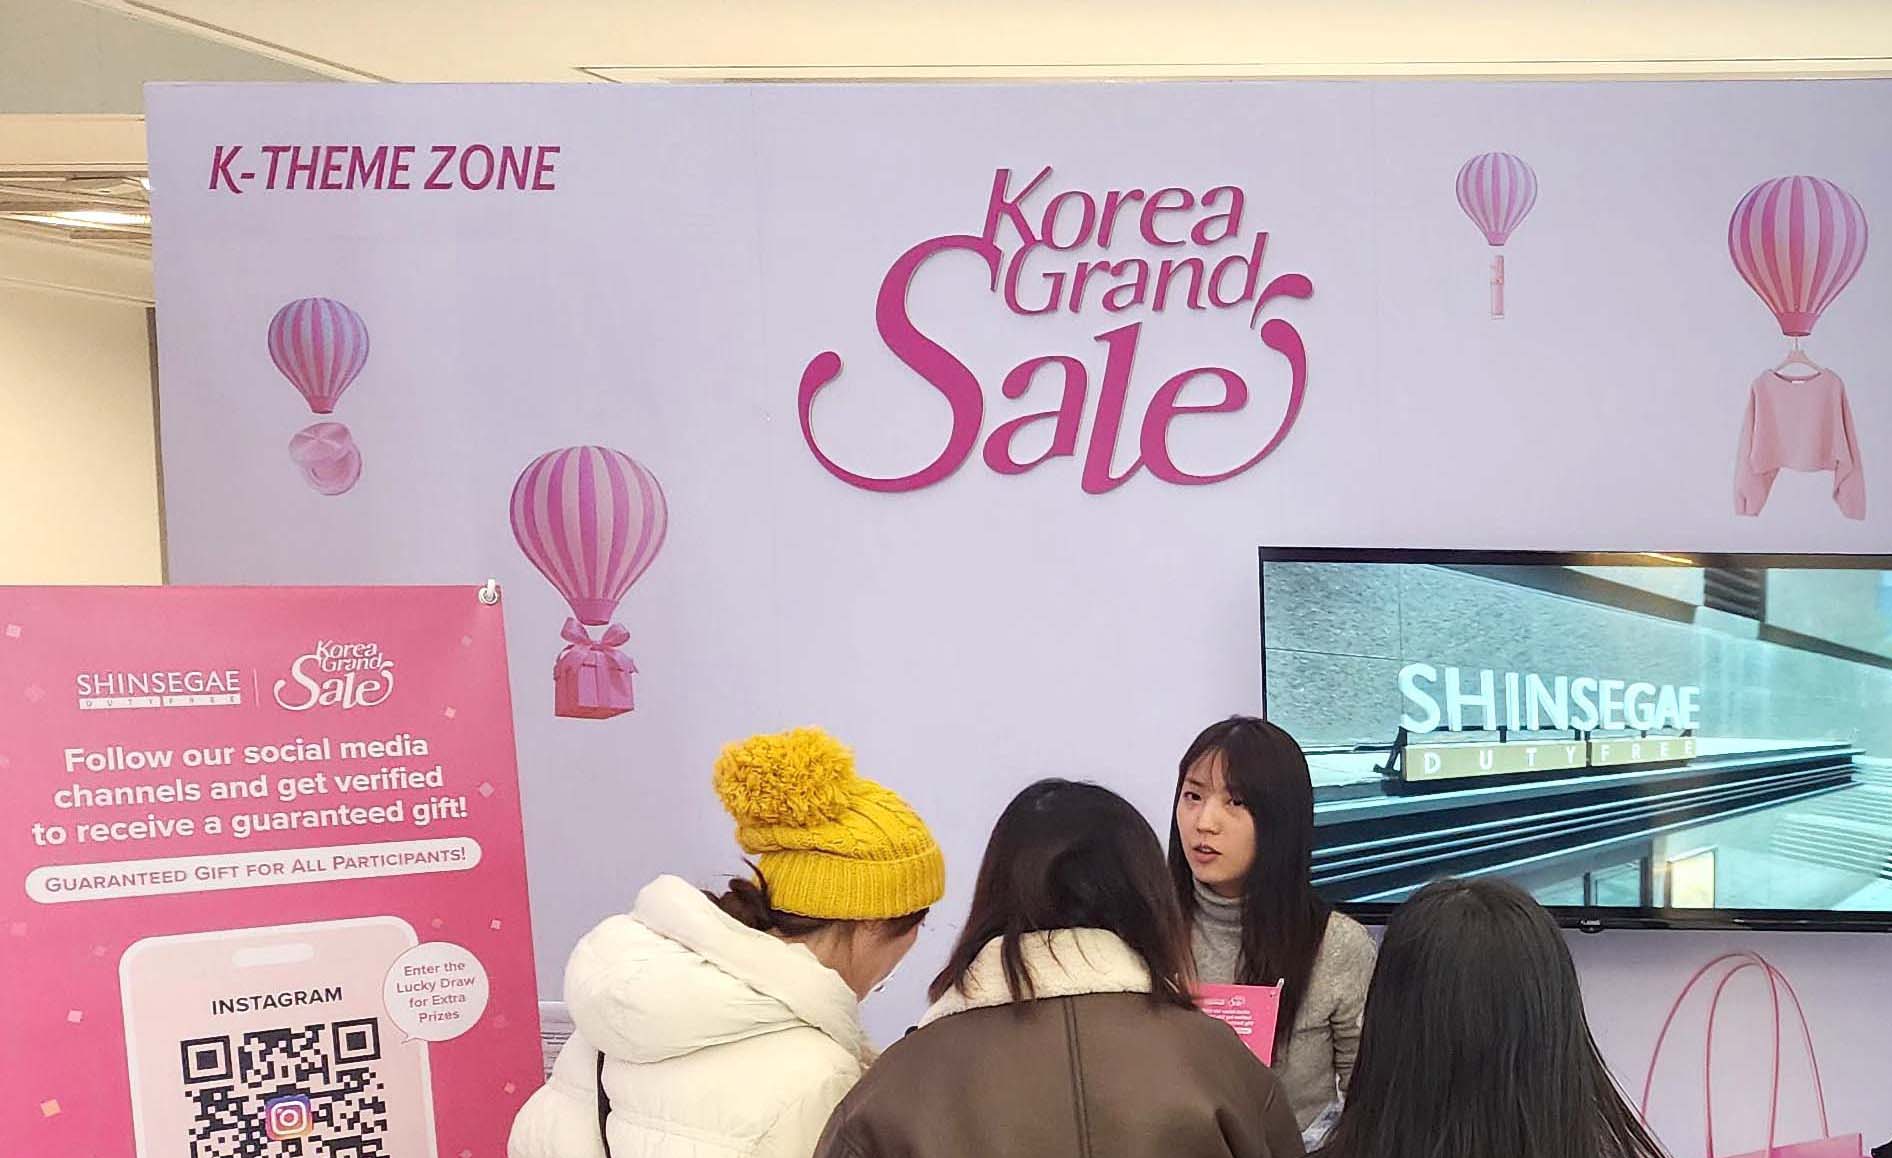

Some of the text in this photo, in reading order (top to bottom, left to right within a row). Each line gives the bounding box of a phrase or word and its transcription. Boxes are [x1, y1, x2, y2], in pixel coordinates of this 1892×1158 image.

[209, 144, 561, 194] K-THEME ZONE
[982, 165, 1245, 250] Korea
[1004, 232, 1269, 316] Grand
[798, 234, 1313, 495] Sale
[316, 639, 378, 659] Korea
[321, 652, 383, 673] Grand
[76, 669, 240, 697] SHINSEGAE
[273, 654, 396, 712] Sale
[1398, 663, 1700, 733] SHINSEGAE
[64, 733, 429, 773] Follow our social media
[1423, 740, 1695, 776] DUTY FREE
[54, 765, 444, 809] channels and get verified
[31, 796, 468, 846] to receive a guaranteed gift!
[45, 869, 187, 893] GUARANTEED
[194, 864, 239, 882] GIFT
[292, 857, 327, 874] ALL
[396, 975, 476, 995] Lucky Draw
[404, 960, 466, 978] Enter the
[211, 986, 343, 1017] INSTAGRAM
[409, 992, 466, 1009] for Extra
[418, 1010, 460, 1024] Prizes
